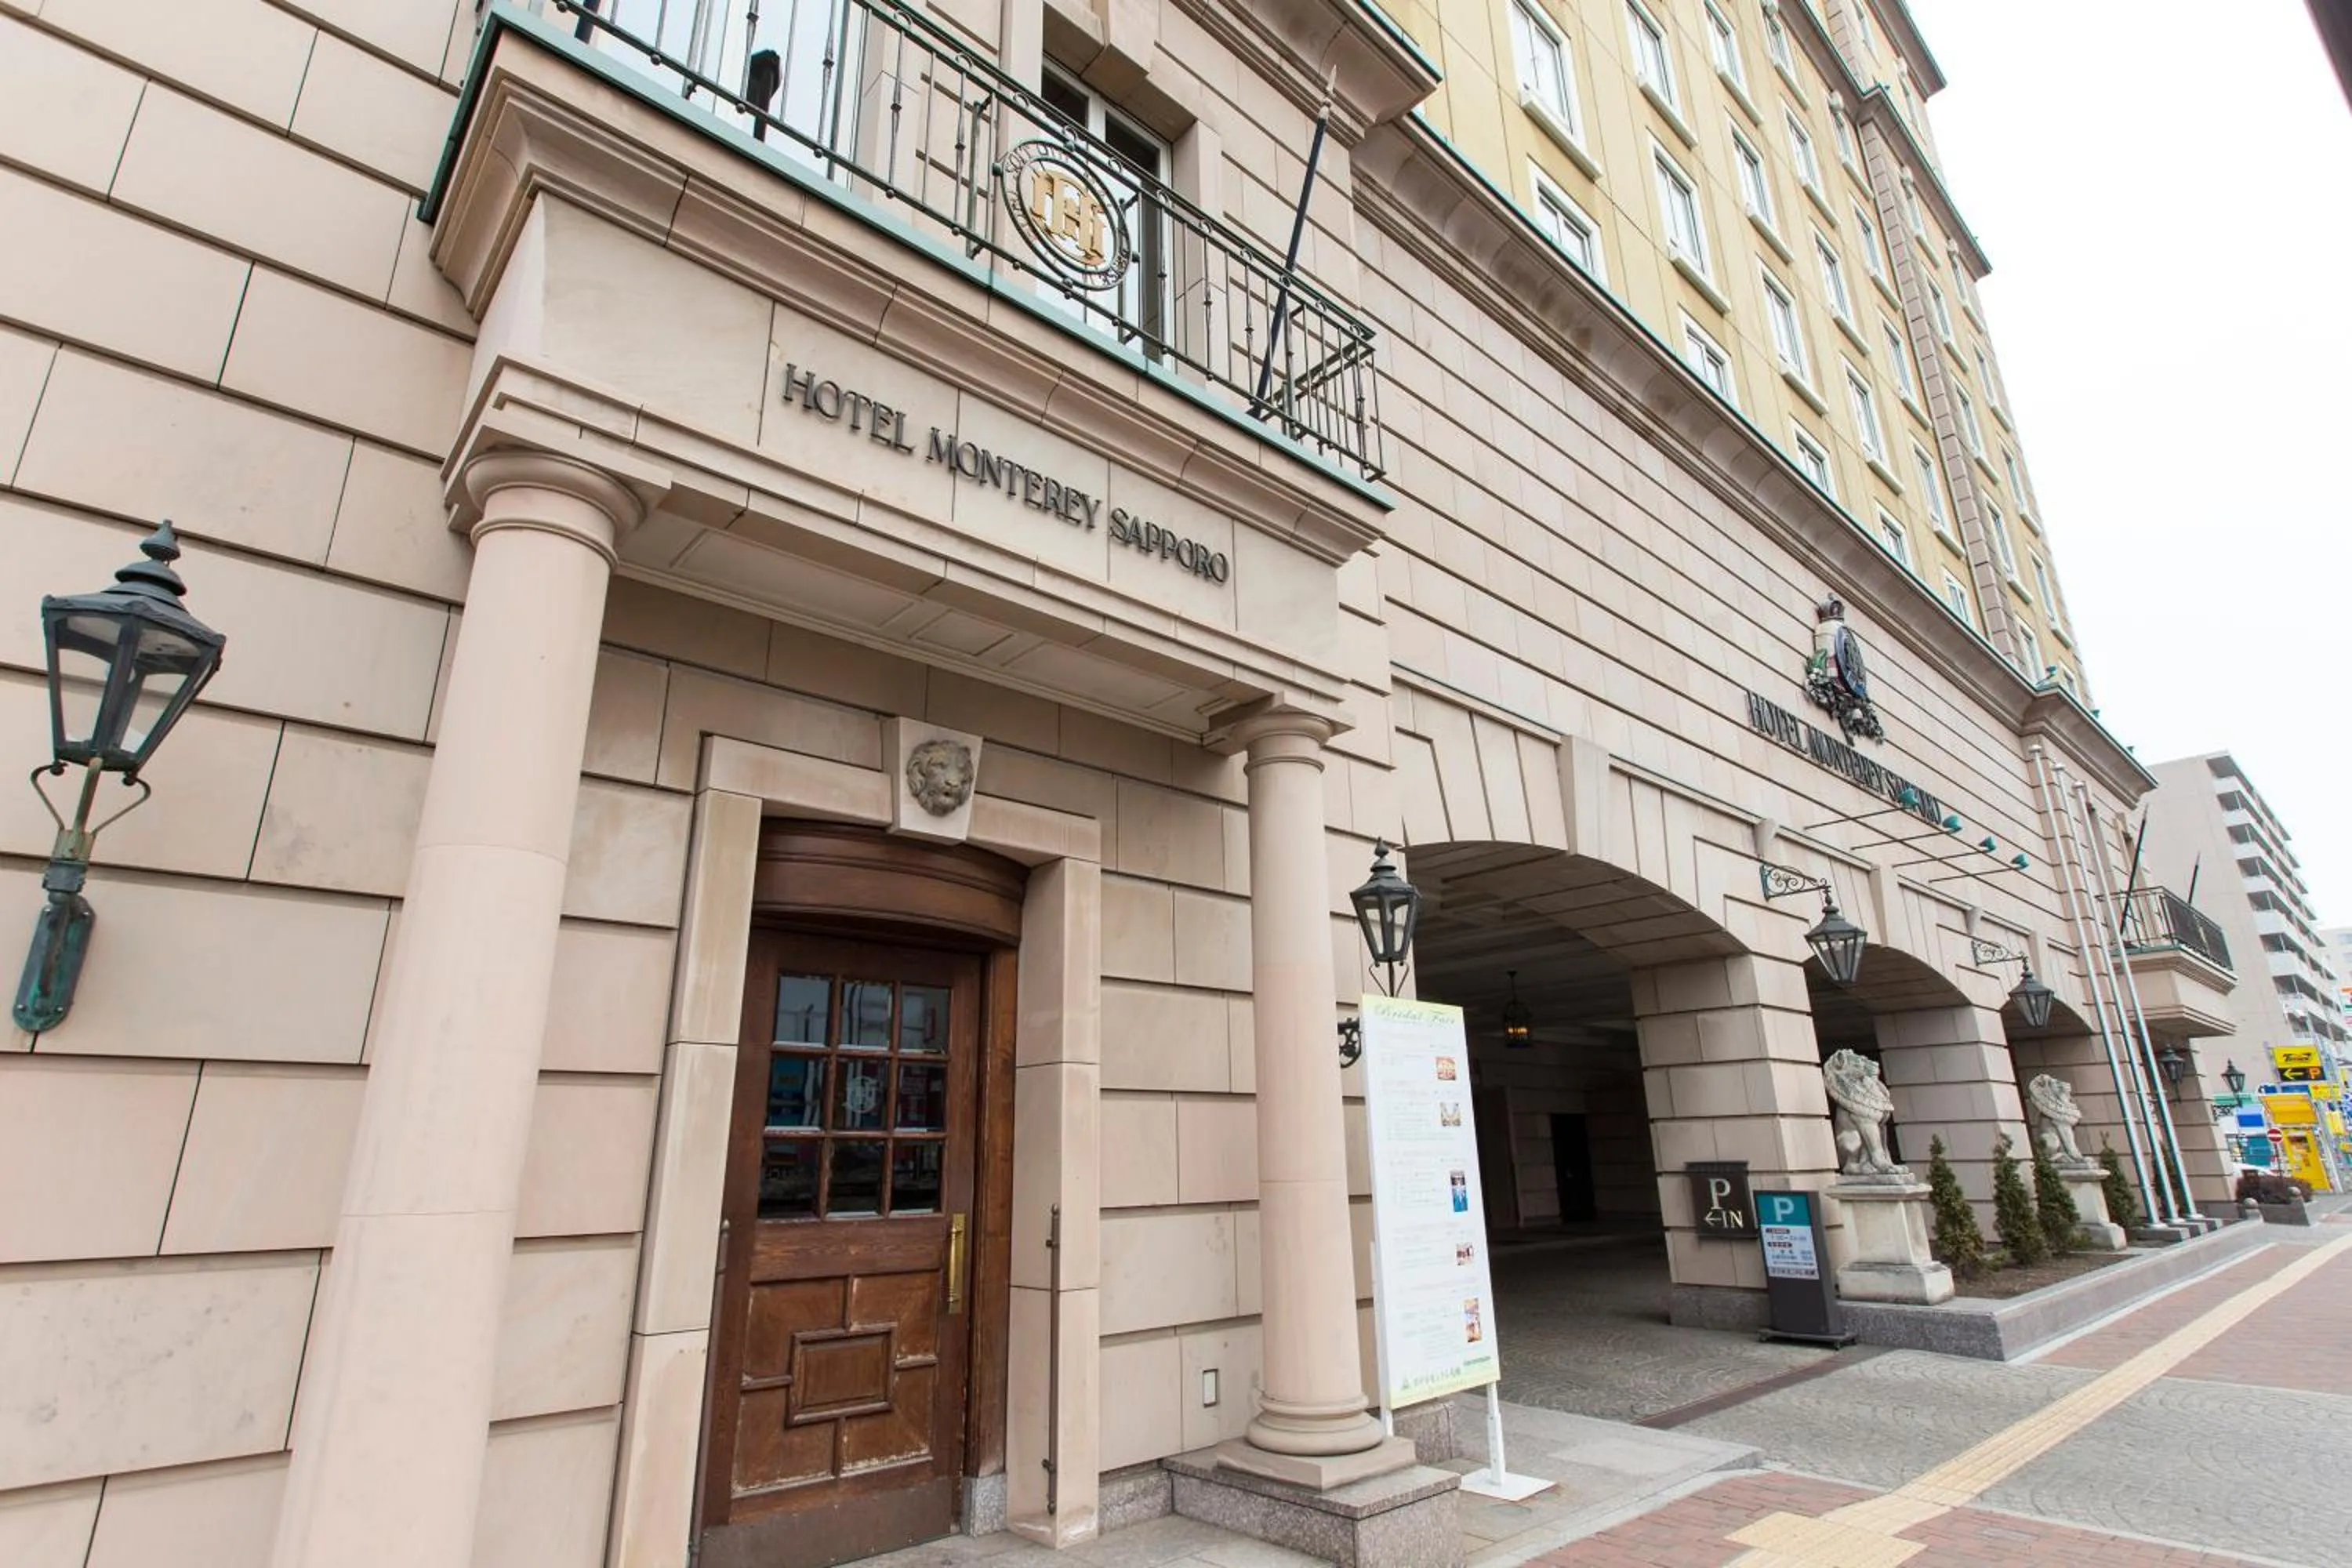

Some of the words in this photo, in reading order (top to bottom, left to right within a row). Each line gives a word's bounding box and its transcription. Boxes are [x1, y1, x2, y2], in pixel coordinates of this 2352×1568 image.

[782, 363, 915, 454] HOTEL
[926, 427, 1101, 529] MONTEREY
[1109, 506, 1229, 586] SAPPORO
[1746, 689, 1808, 754] HOTEL
[2309, 1067, 2321, 1079] P
[1708, 1178, 1731, 1210] P
[1722, 1210, 1744, 1229] IN
[1773, 1197, 1795, 1222] P
